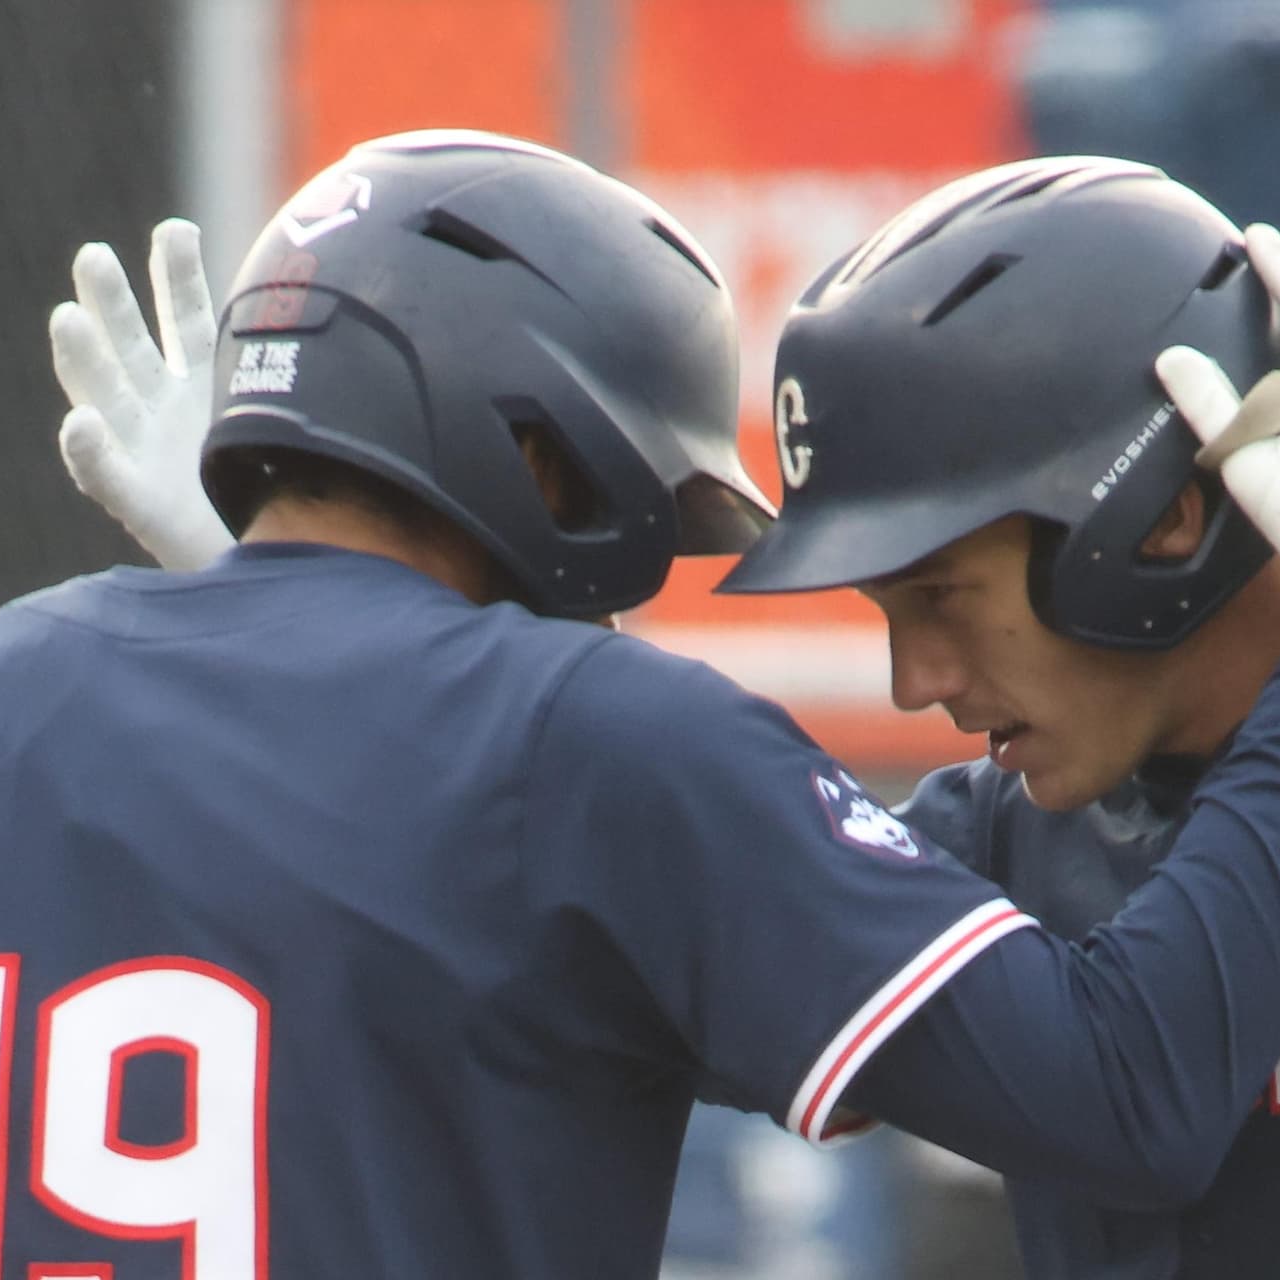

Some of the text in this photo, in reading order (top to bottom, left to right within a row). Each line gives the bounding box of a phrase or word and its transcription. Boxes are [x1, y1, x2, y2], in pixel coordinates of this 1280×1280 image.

[262, 341, 300, 368] THE
[229, 367, 297, 395] CHANGE
[776, 377, 813, 490] C
